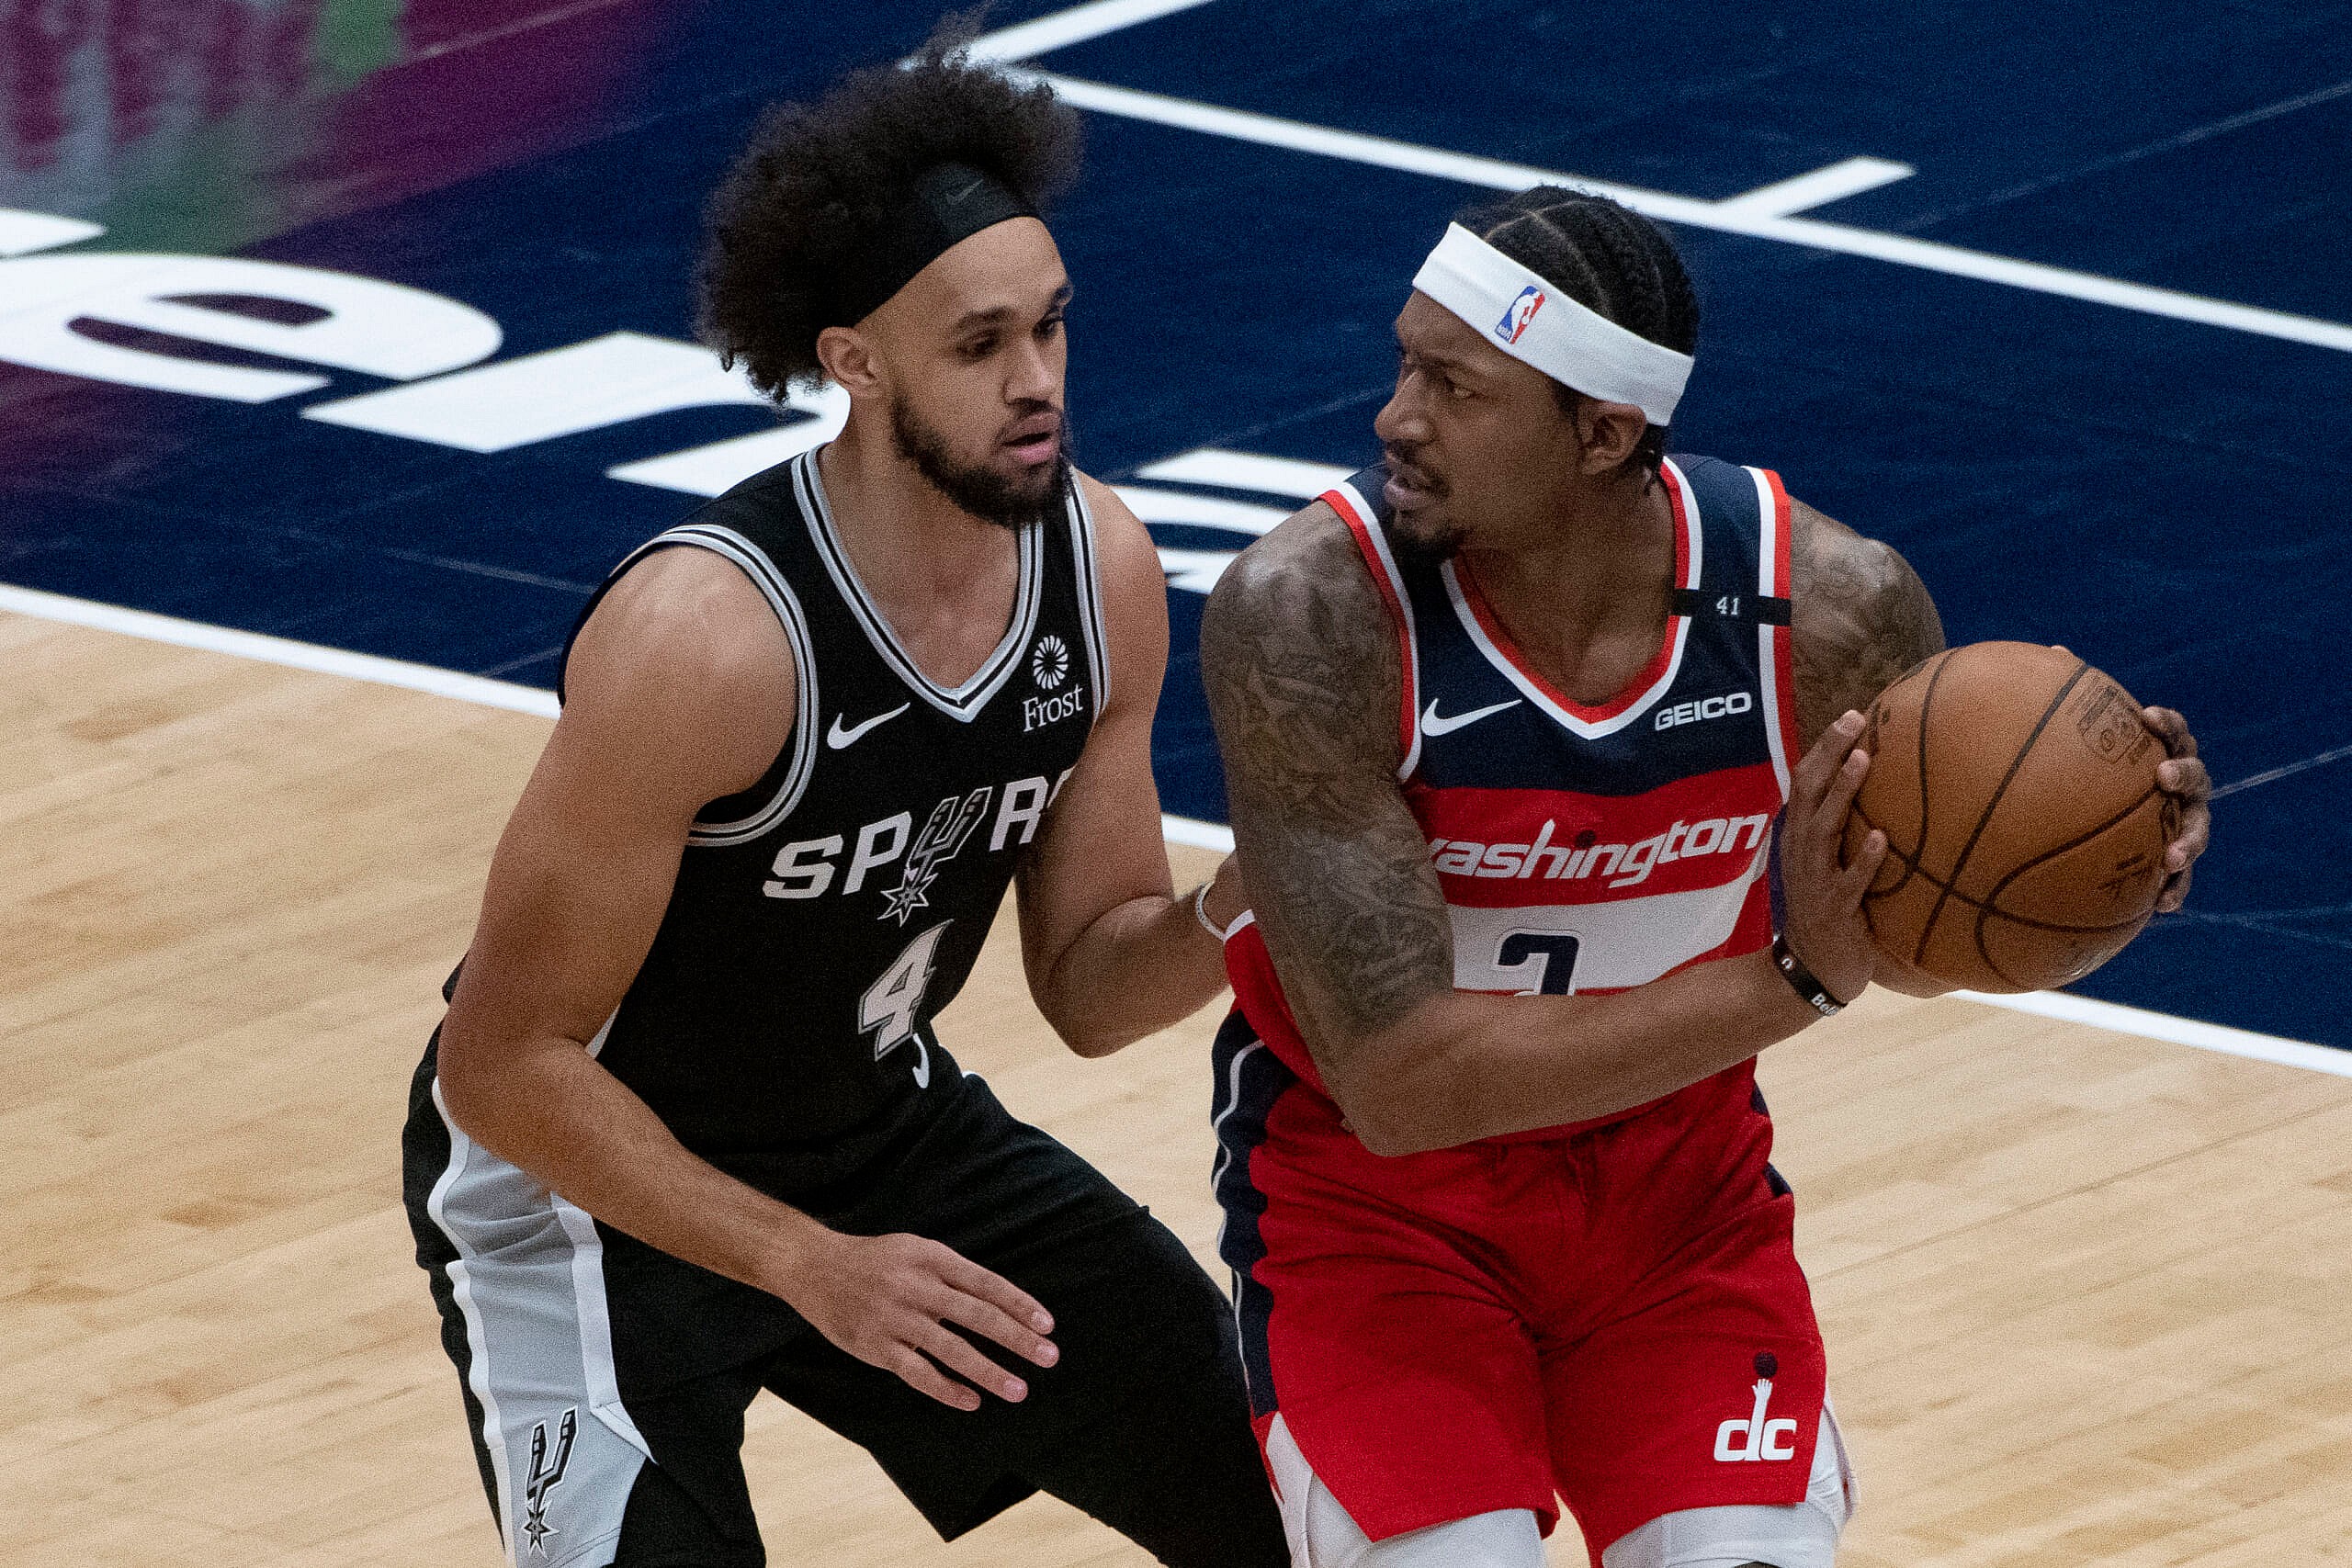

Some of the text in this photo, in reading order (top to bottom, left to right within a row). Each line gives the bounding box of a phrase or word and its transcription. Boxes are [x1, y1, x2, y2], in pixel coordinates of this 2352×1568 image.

[1716, 596, 1740, 615] 41
[1023, 683, 1084, 732] Frost
[1655, 692, 1753, 731] GEICO
[763, 768, 1075, 926] SPUR
[1430, 813, 1770, 889] ashington
[858, 919, 955, 1061] 4
[1713, 1378, 1798, 1461] dc
